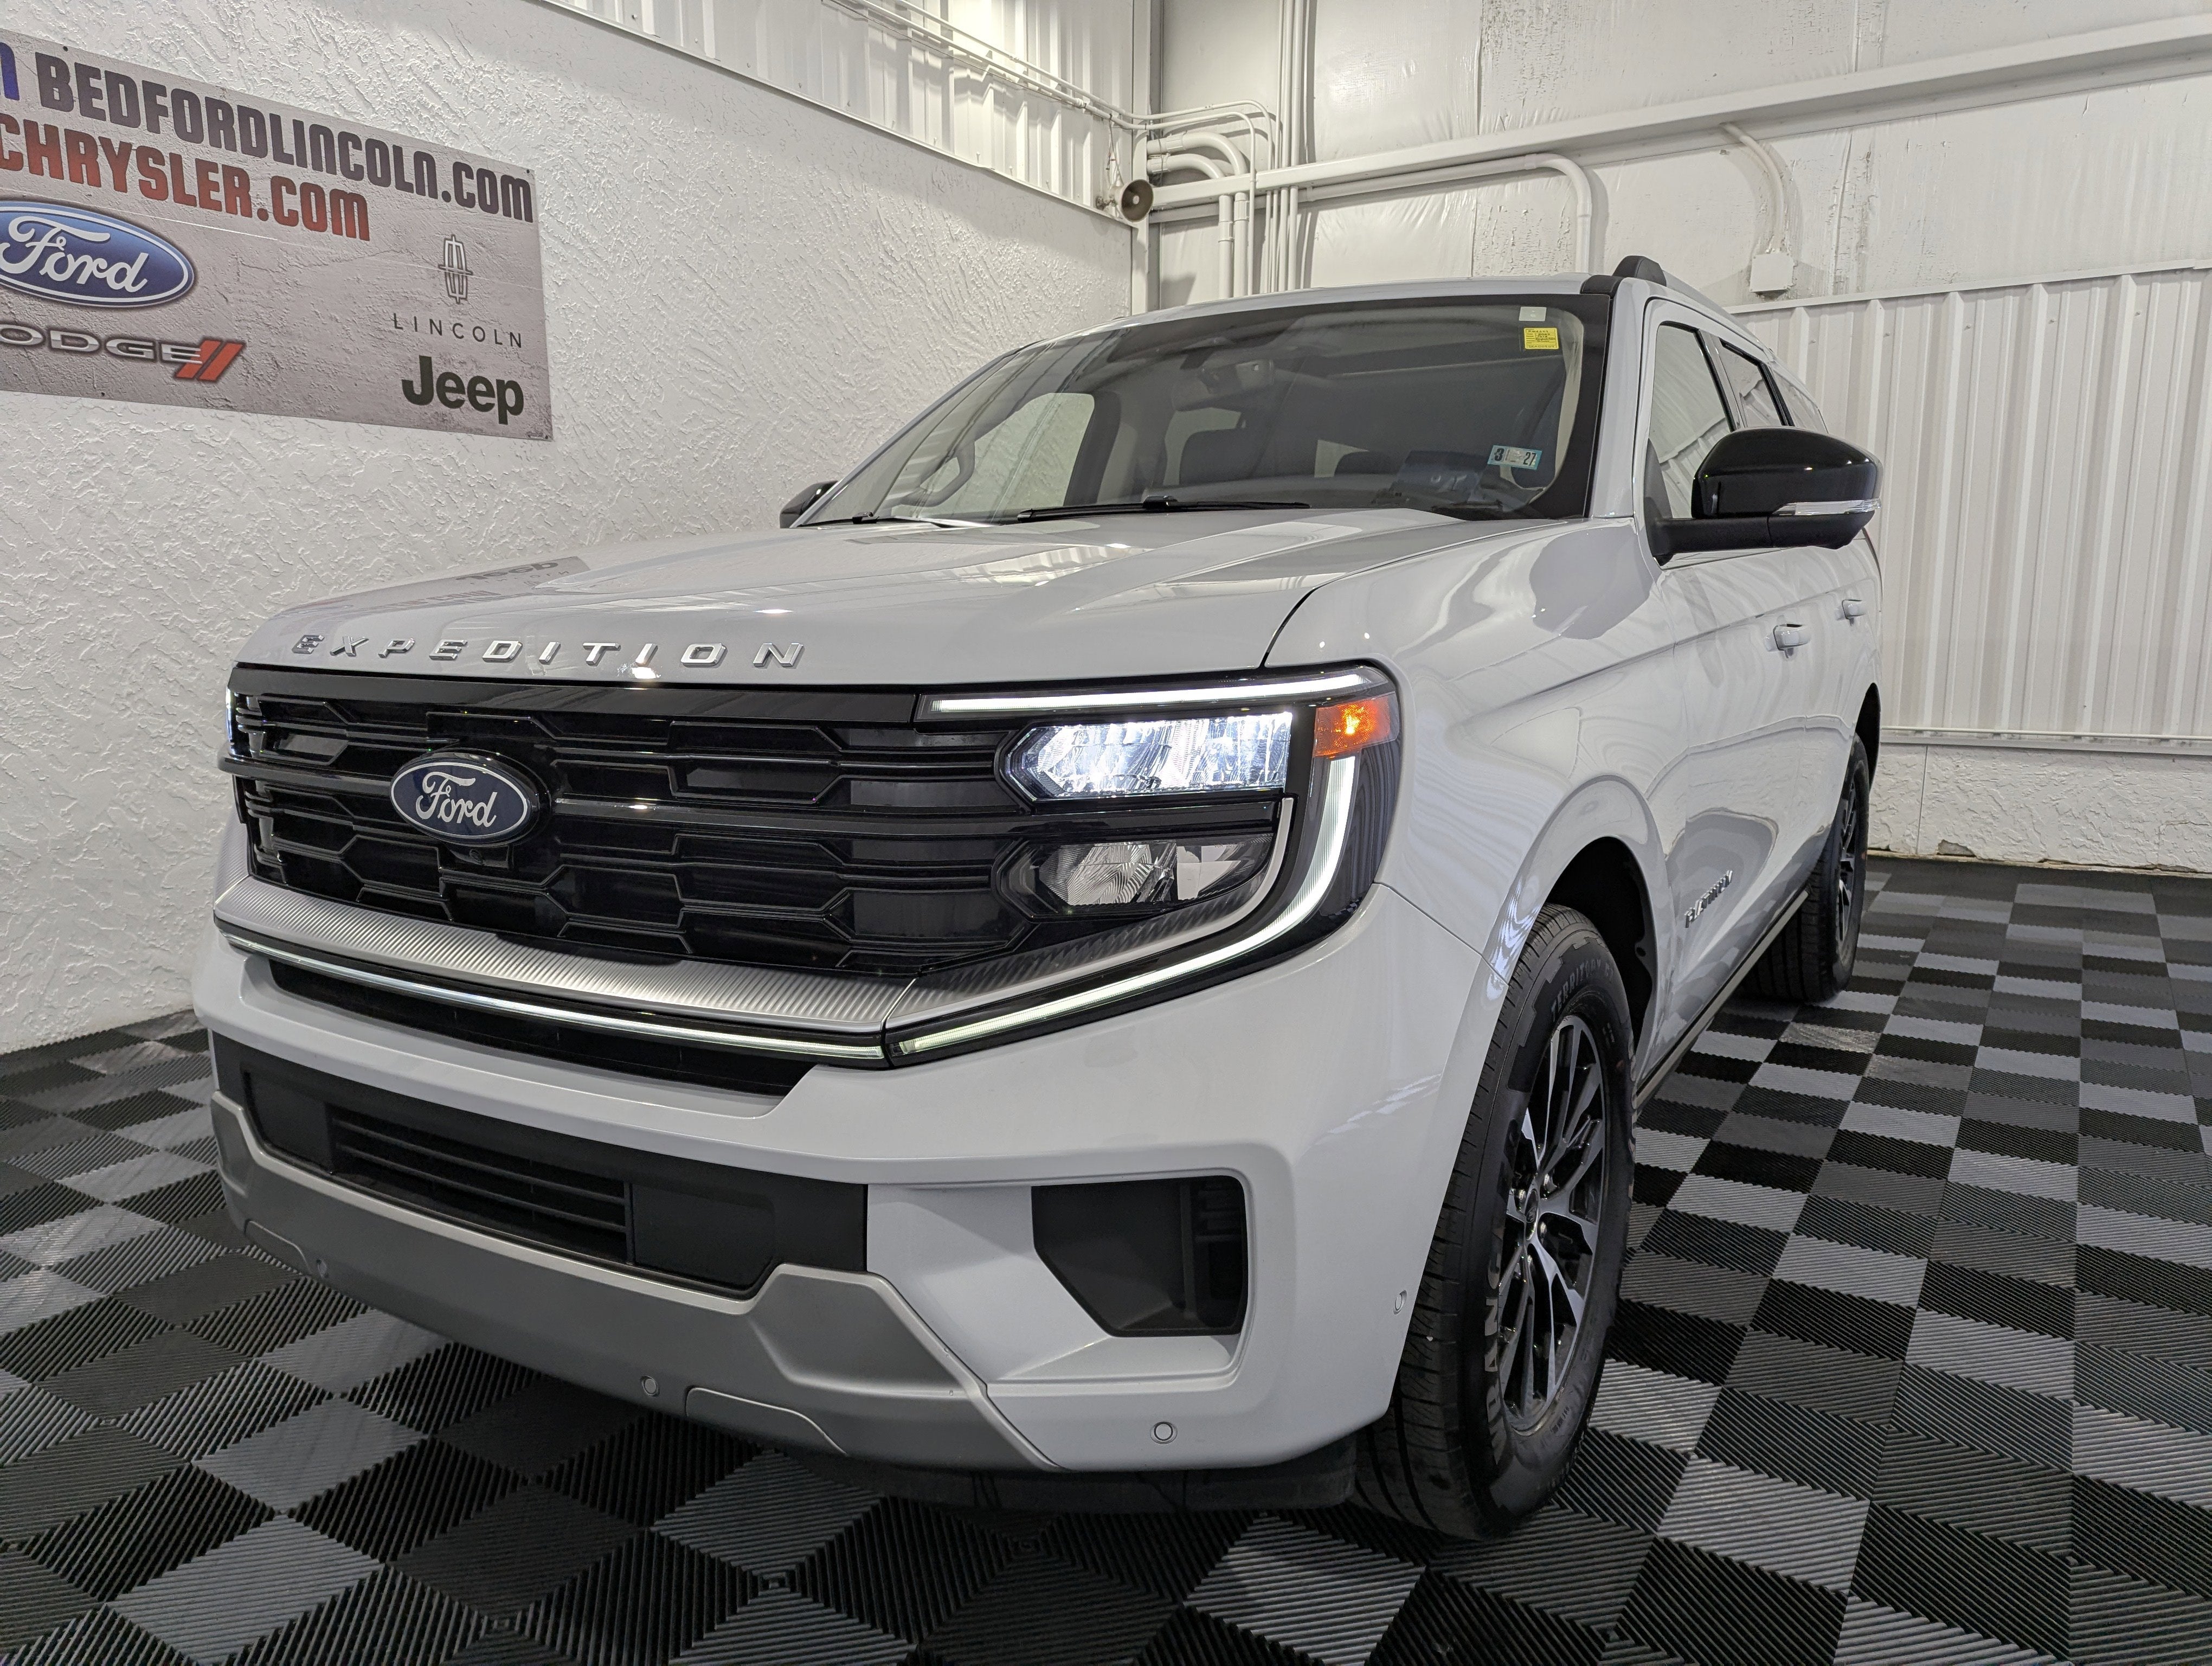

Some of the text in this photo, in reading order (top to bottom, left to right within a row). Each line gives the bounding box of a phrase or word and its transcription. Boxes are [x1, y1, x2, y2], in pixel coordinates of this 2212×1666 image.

[35, 52, 533, 223] BEDFORDLINCOLN.COM
[0, 216, 149, 293] Ford
[394, 313, 522, 348] LINCOLN
[402, 355, 524, 426] Jeep
[1495, 448, 1504, 462] 3
[1523, 452, 1536, 466] 27
[291, 634, 805, 668] EXPEDITION
[415, 771, 498, 828] Ford
